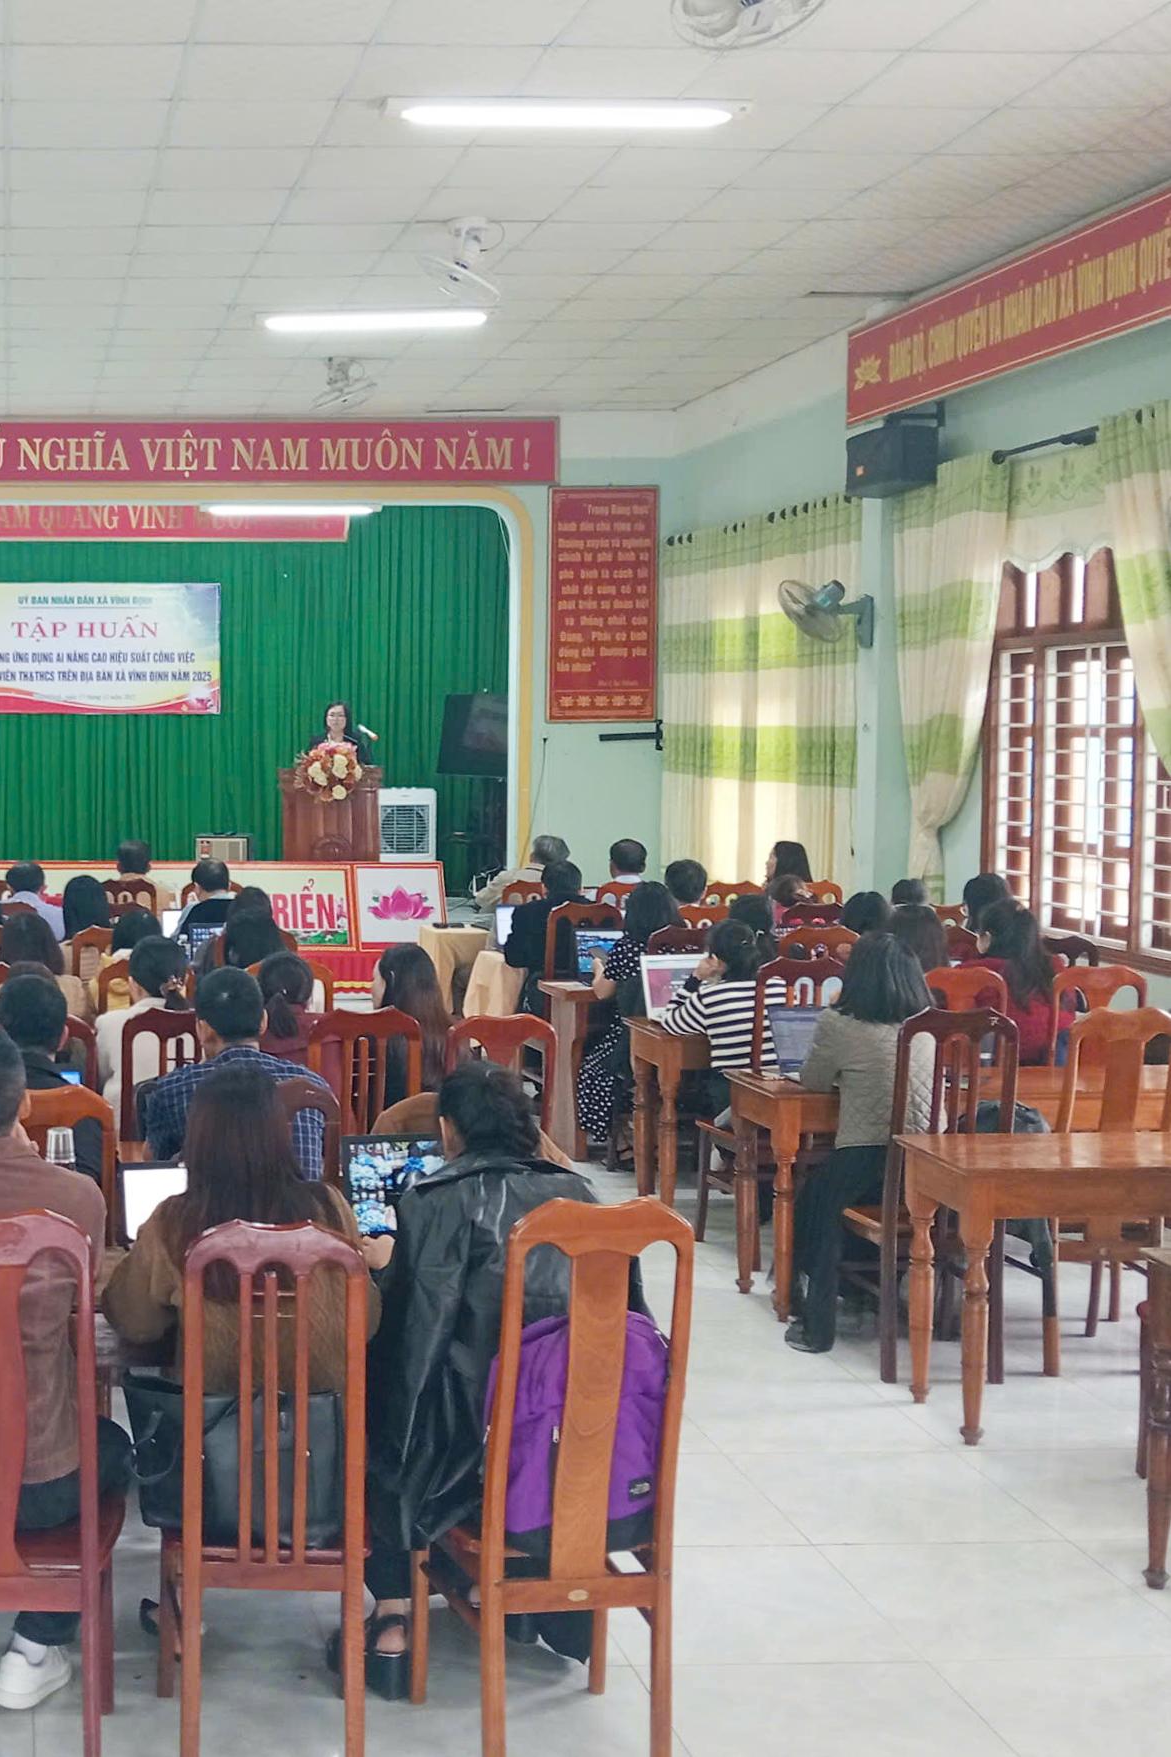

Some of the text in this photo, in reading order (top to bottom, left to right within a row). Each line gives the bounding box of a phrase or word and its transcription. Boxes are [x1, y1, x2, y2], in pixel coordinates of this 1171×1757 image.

[17, 431, 130, 472] NGHĨA
[140, 430, 223, 478] VIỆT
[230, 437, 309, 472] NAM
[319, 429, 424, 472] MUÔN
[433, 431, 515, 472] NĂM
[11, 614, 159, 642] TẬP HUẤN
[192, 671, 212, 682] 2025
[269, 878, 336, 930] RIỂN
